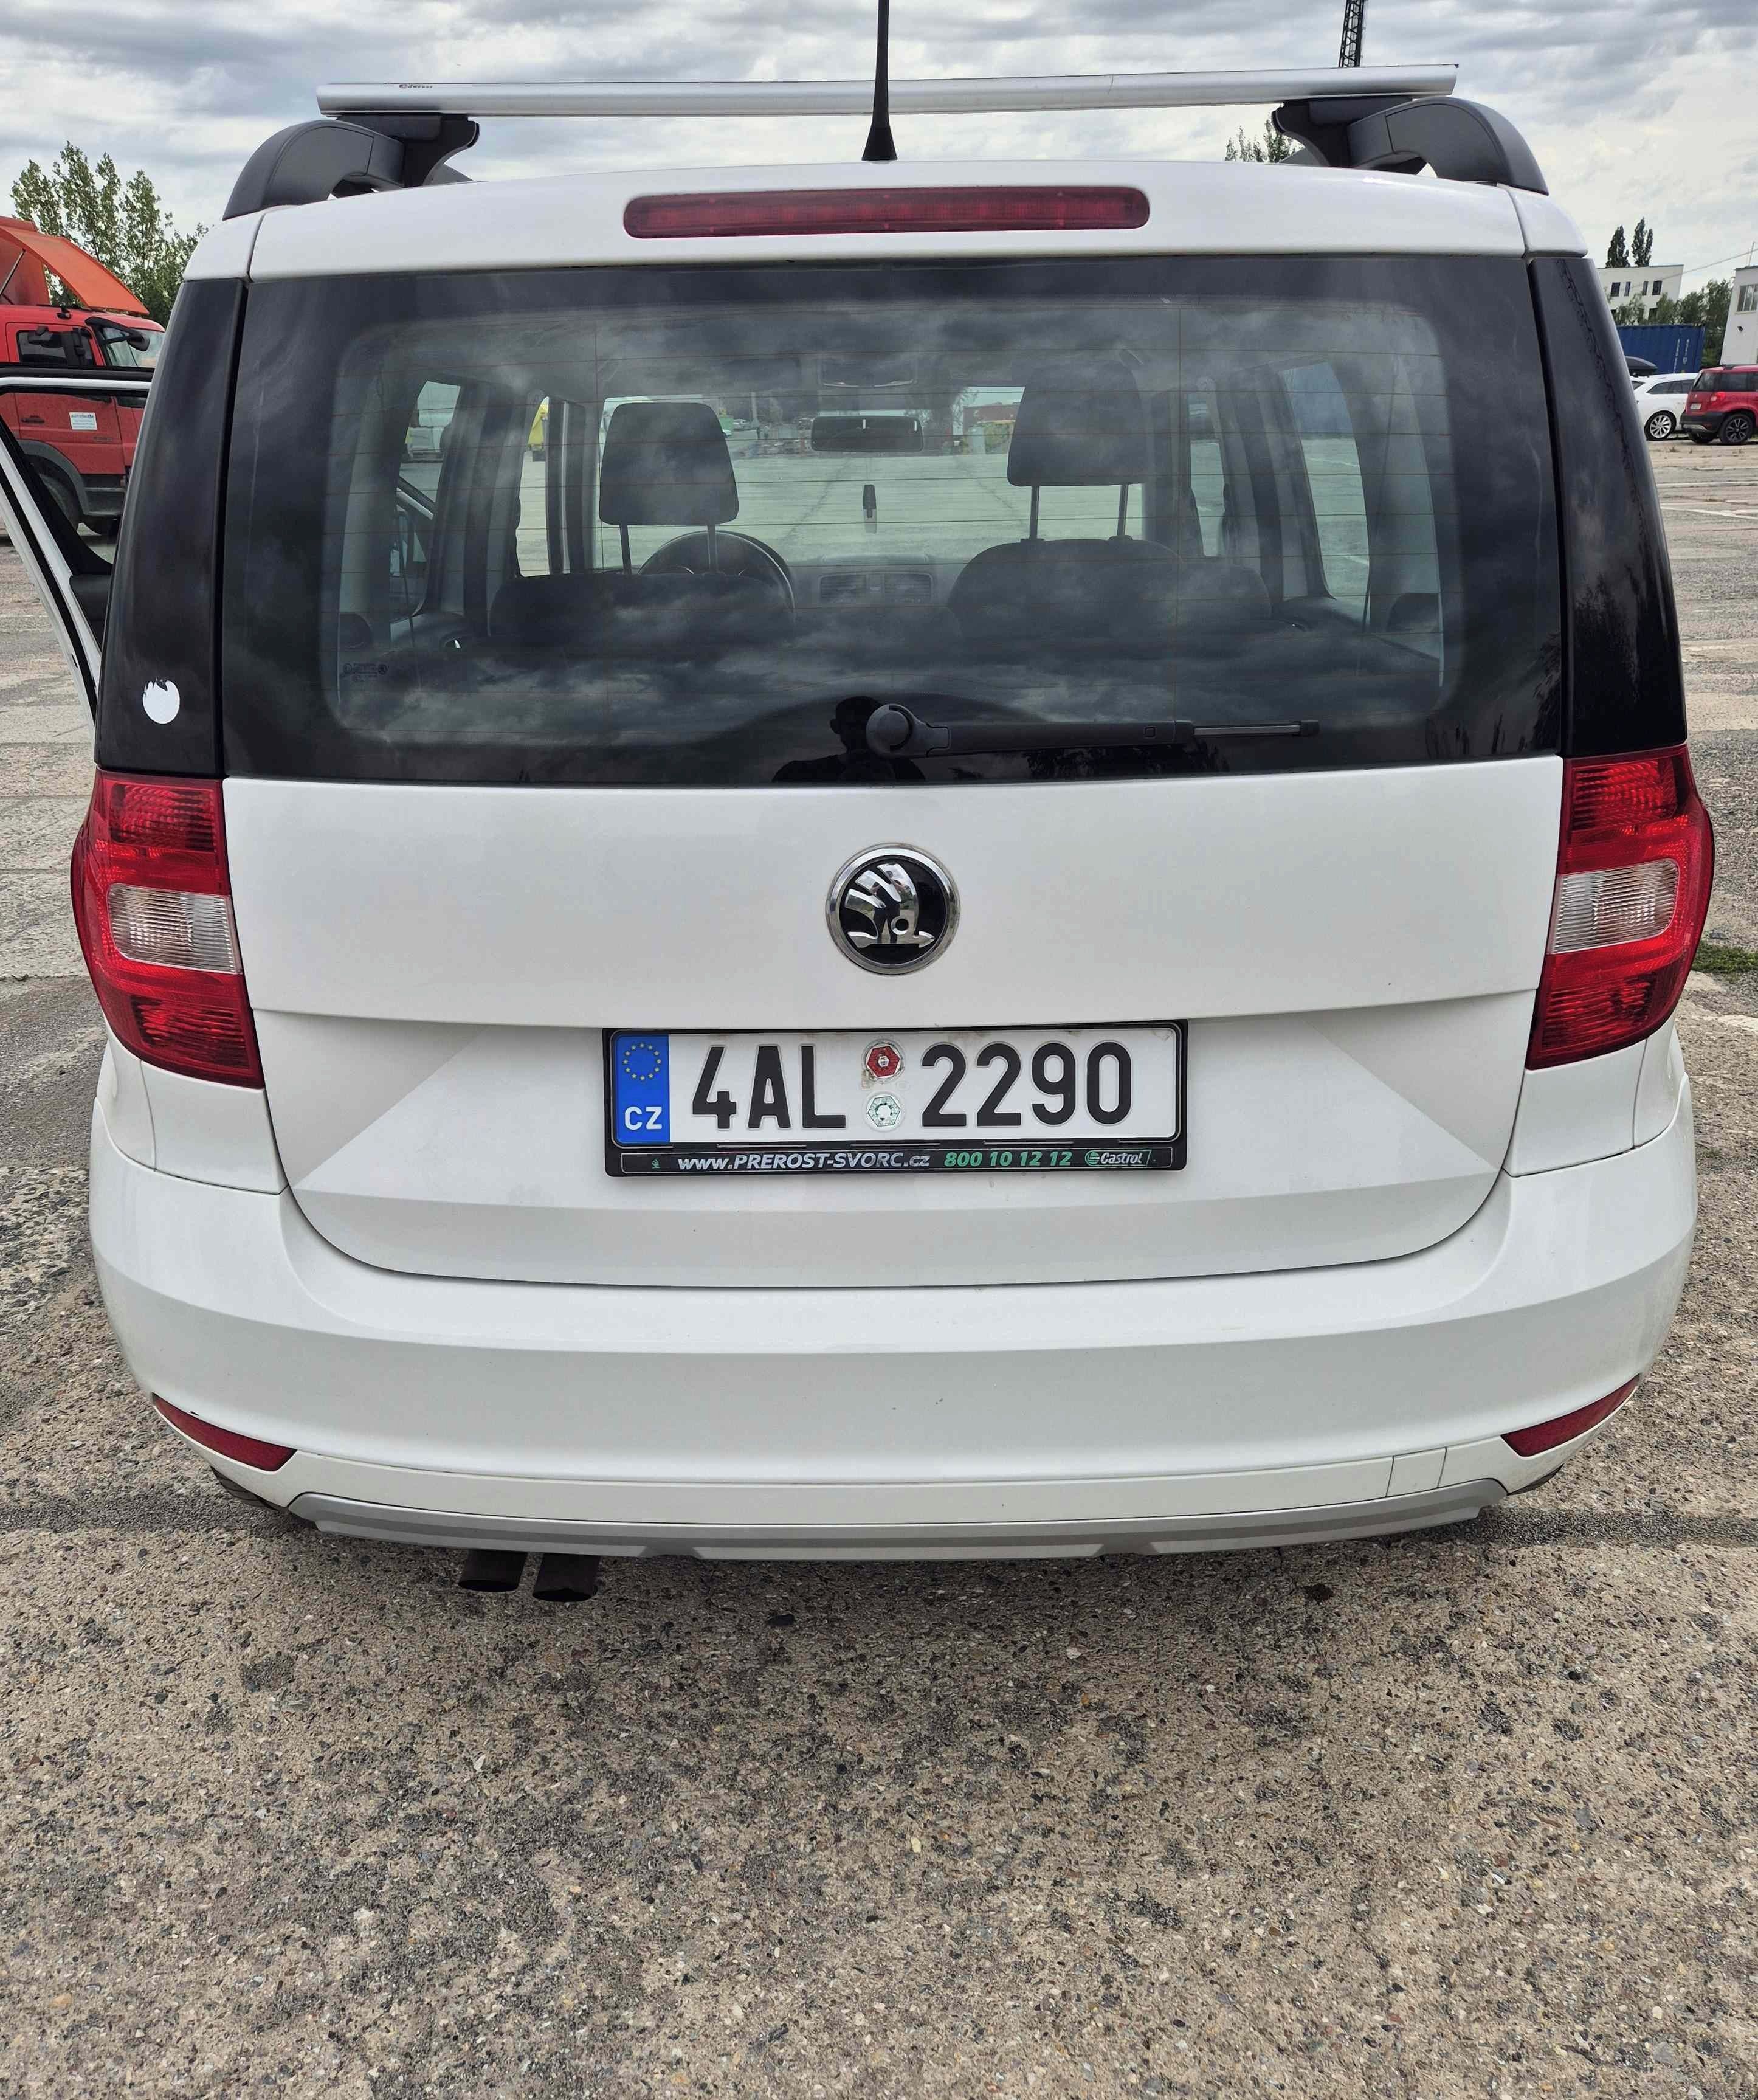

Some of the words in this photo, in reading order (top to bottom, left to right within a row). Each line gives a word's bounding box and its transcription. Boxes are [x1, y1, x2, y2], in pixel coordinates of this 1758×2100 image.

[692, 1045, 847, 1130] 4AL
[922, 1041, 1133, 1128] 2290
[624, 1106, 663, 1131] CZ
[678, 1152, 930, 1170] www.PREROST-SVORC.cz
[944, 1152, 983, 1167] 800
[990, 1151, 1013, 1167] 10
[1020, 1151, 1043, 1166] 12
[1050, 1150, 1073, 1166] 12
[1100, 1152, 1143, 1165] Castrol
